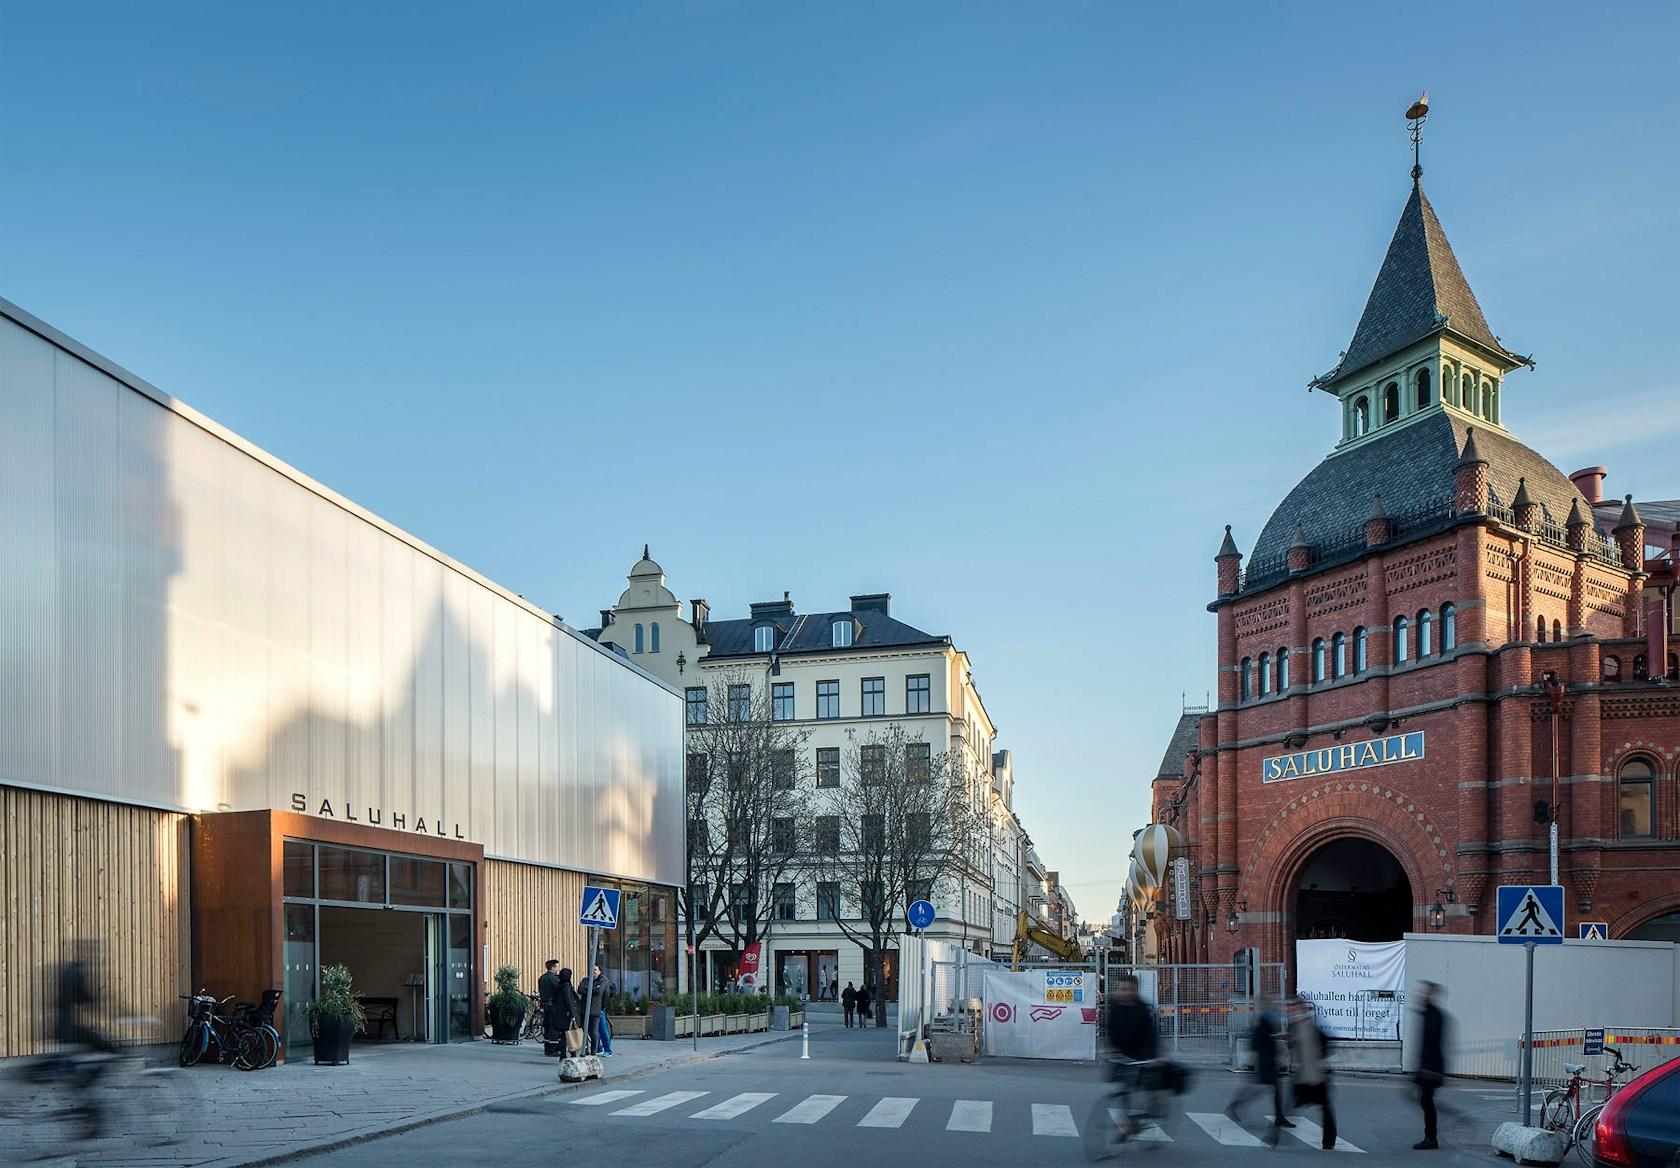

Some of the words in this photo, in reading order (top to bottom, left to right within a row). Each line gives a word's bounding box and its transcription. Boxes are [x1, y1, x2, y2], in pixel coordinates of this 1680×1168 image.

[1268, 735, 1416, 780] SALUHALL
[291, 793, 464, 839] SALUHALL
[1177, 860, 1188, 917] SALUHALL
[1300, 990, 1345, 1001] Saluhallen
[1331, 970, 1372, 978] SALUHALL
